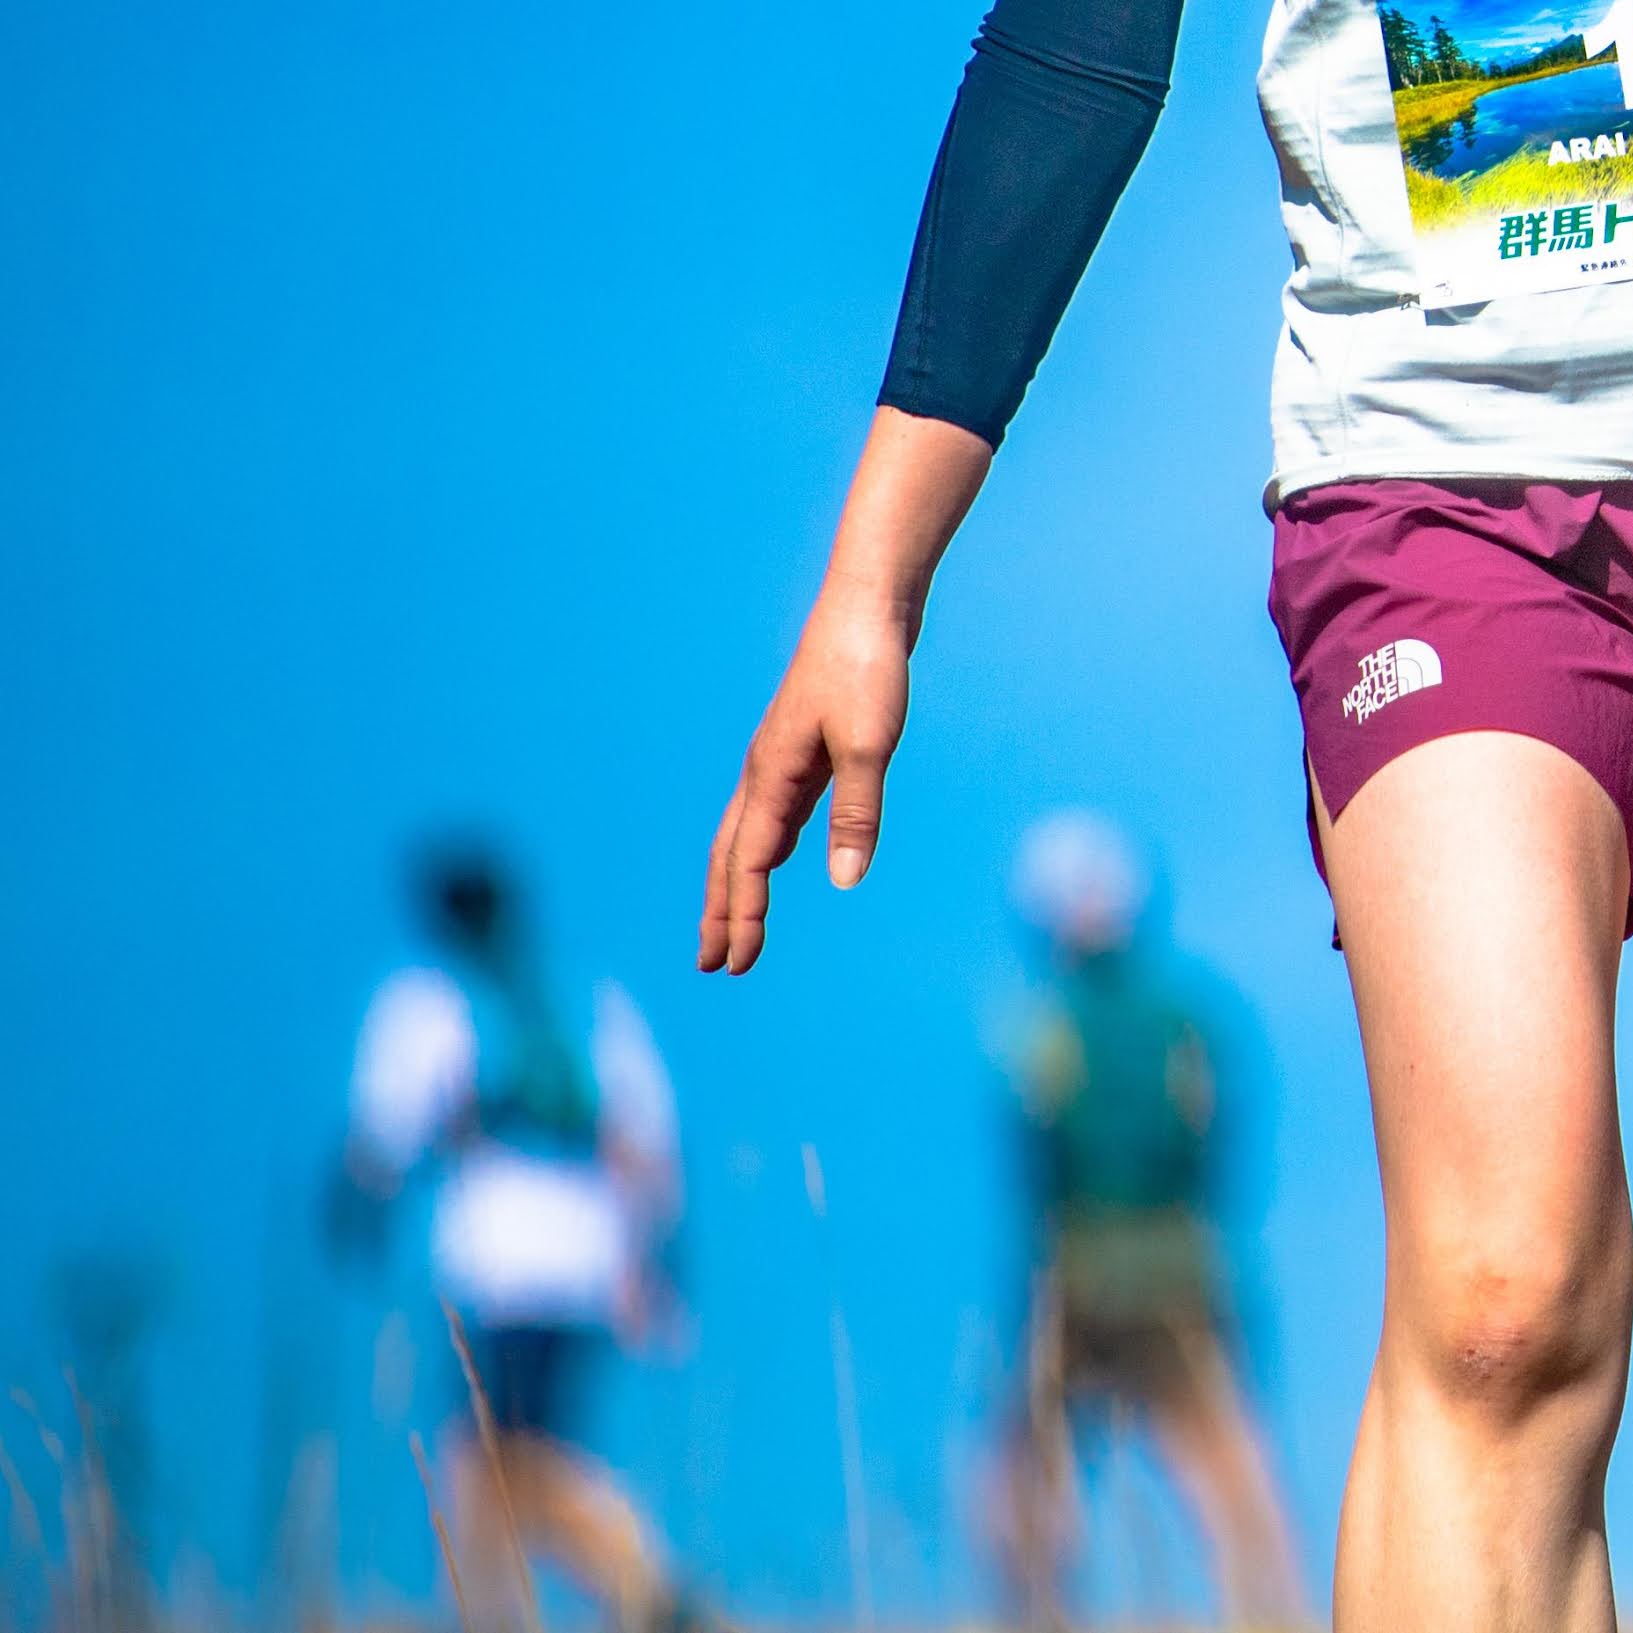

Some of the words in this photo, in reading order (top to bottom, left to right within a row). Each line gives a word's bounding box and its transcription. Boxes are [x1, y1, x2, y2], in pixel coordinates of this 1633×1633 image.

[1548, 131, 1627, 167] ARAI
[1358, 642, 1396, 678] THE
[1341, 659, 1398, 718] NORTH
[1356, 682, 1399, 725] FACE
